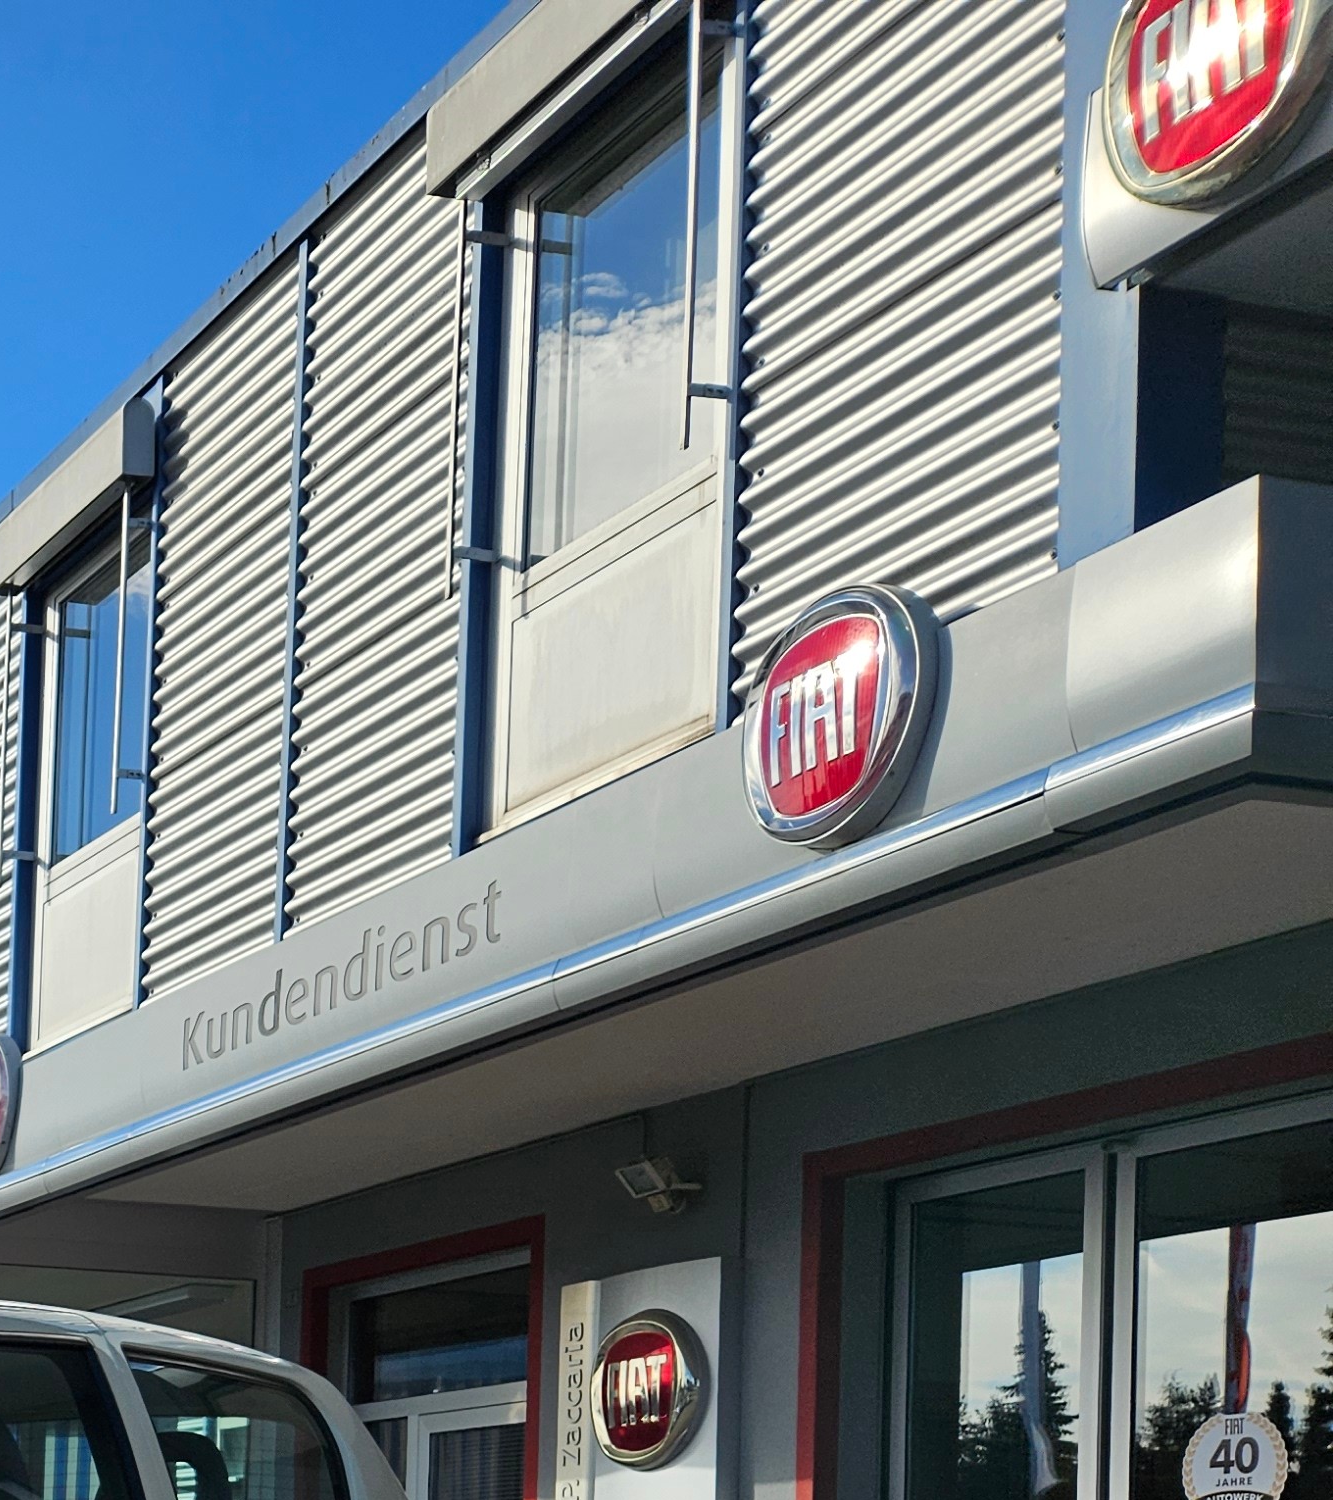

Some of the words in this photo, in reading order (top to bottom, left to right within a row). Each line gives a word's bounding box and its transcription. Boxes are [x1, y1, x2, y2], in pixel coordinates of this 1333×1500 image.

[770, 643, 871, 789] FIAT
[182, 879, 502, 1072] Kundendienst
[562, 1321, 585, 1468] Zaccaria
[606, 1353, 668, 1430] FIAT
[1224, 1417, 1246, 1436] FIAT
[1208, 1436, 1260, 1475] 40
[1214, 1476, 1254, 1488] JAHRE
